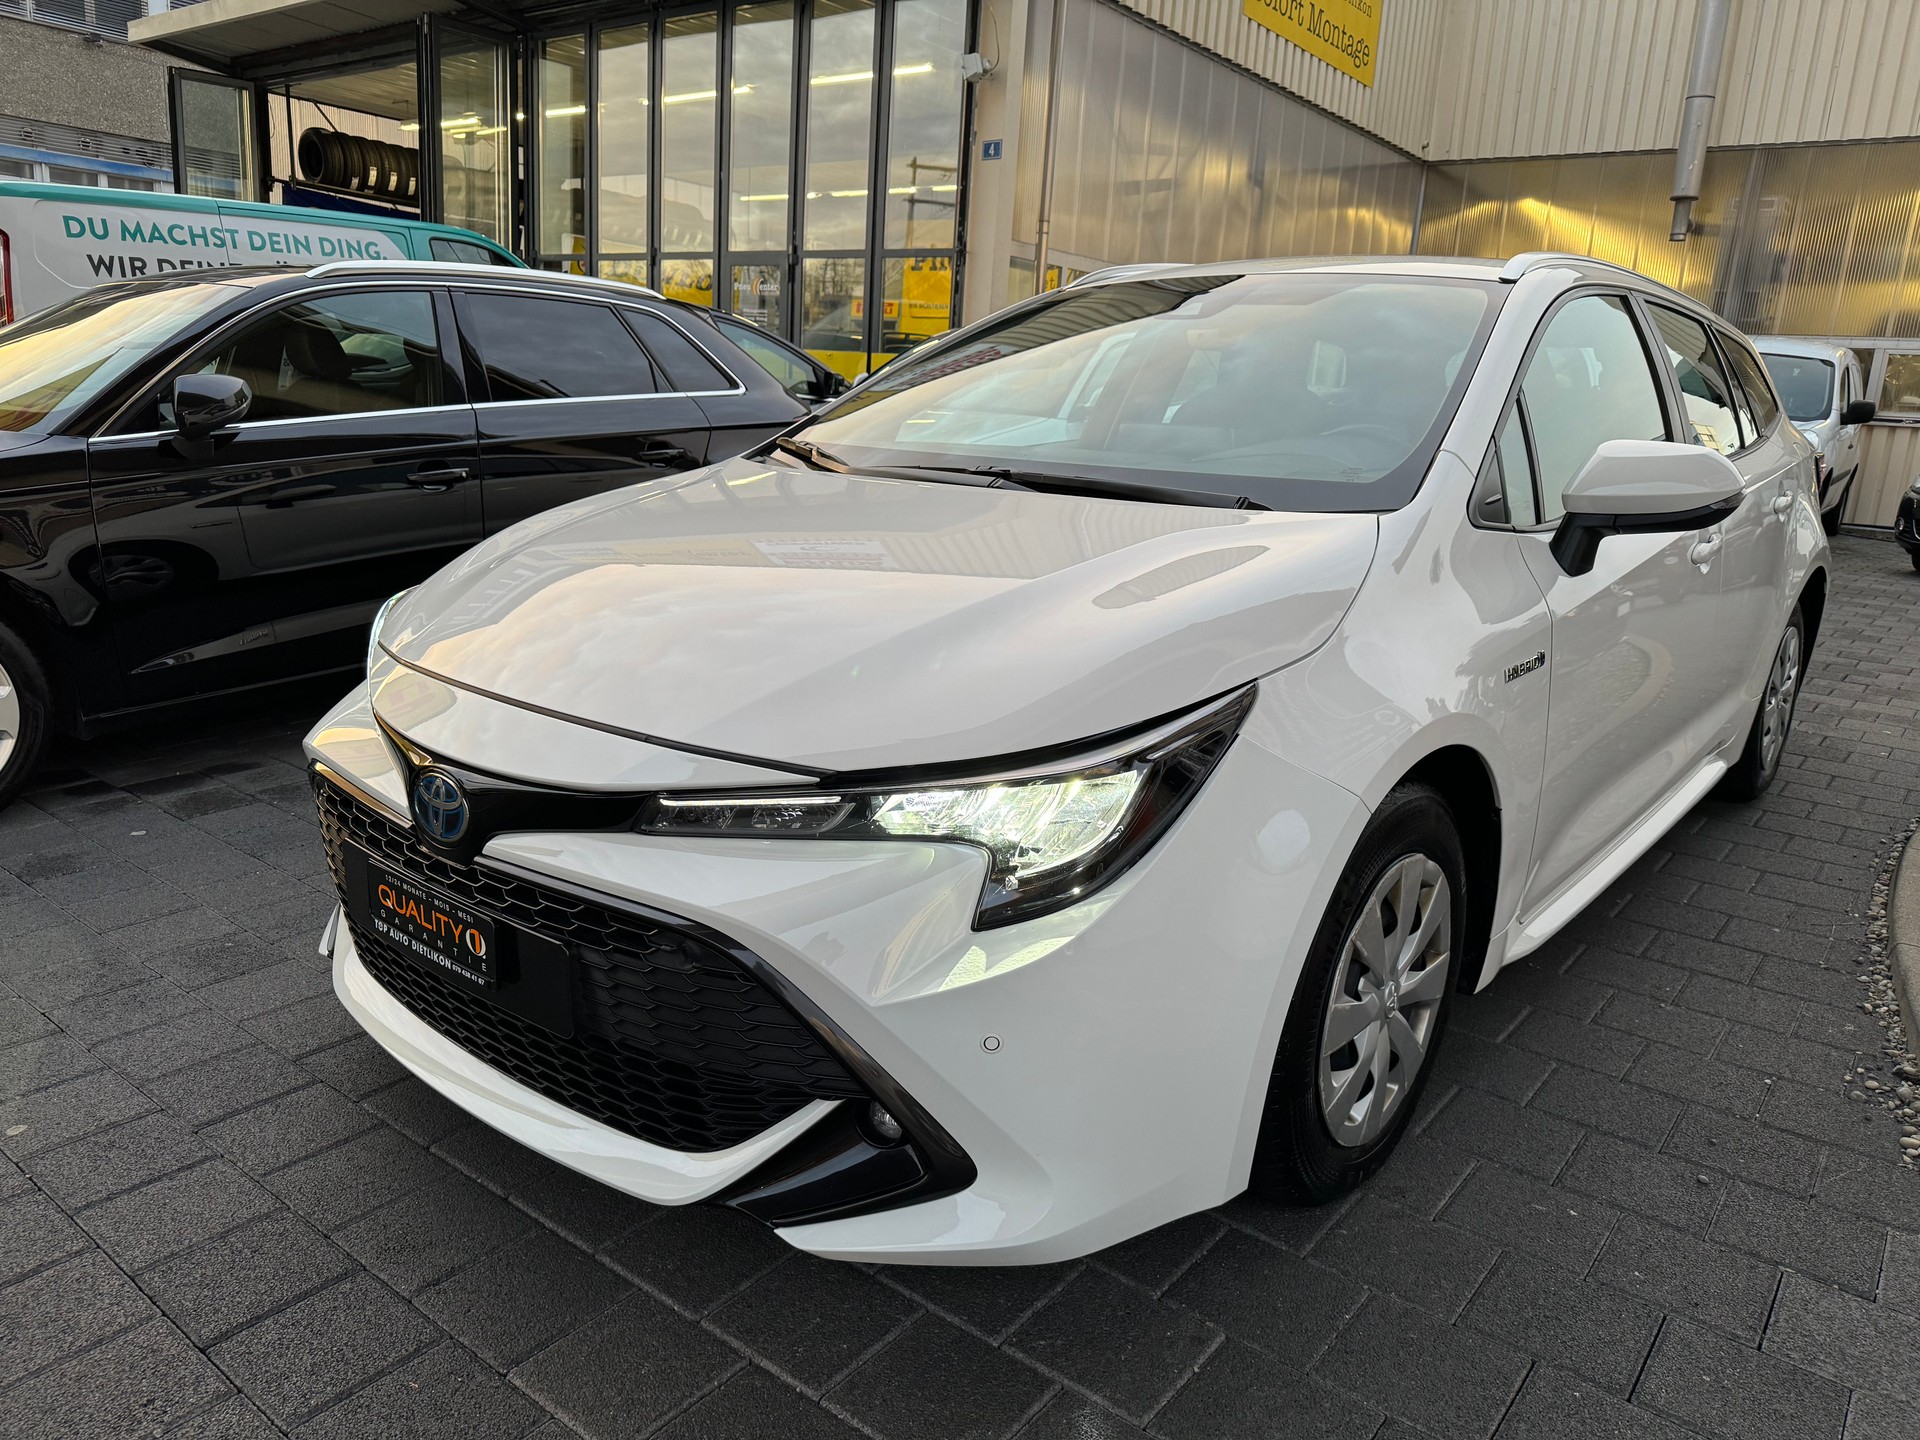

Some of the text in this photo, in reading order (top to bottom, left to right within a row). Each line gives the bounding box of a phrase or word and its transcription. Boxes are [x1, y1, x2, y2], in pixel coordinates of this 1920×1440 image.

[1307, 2, 1370, 68] Montage
[988, 143, 995, 157] 4
[62, 215, 388, 260] DU MACHST DEIN DING.
[86, 253, 148, 278] WIR
[385, 874, 401, 887] 12/24
[402, 882, 427, 900] MONATE
[433, 898, 450, 912] MOIS
[457, 910, 474, 924] MESI
[374, 918, 388, 933] TOP
[389, 927, 409, 946] AUTO
[411, 939, 452, 970] DIETLIKON
